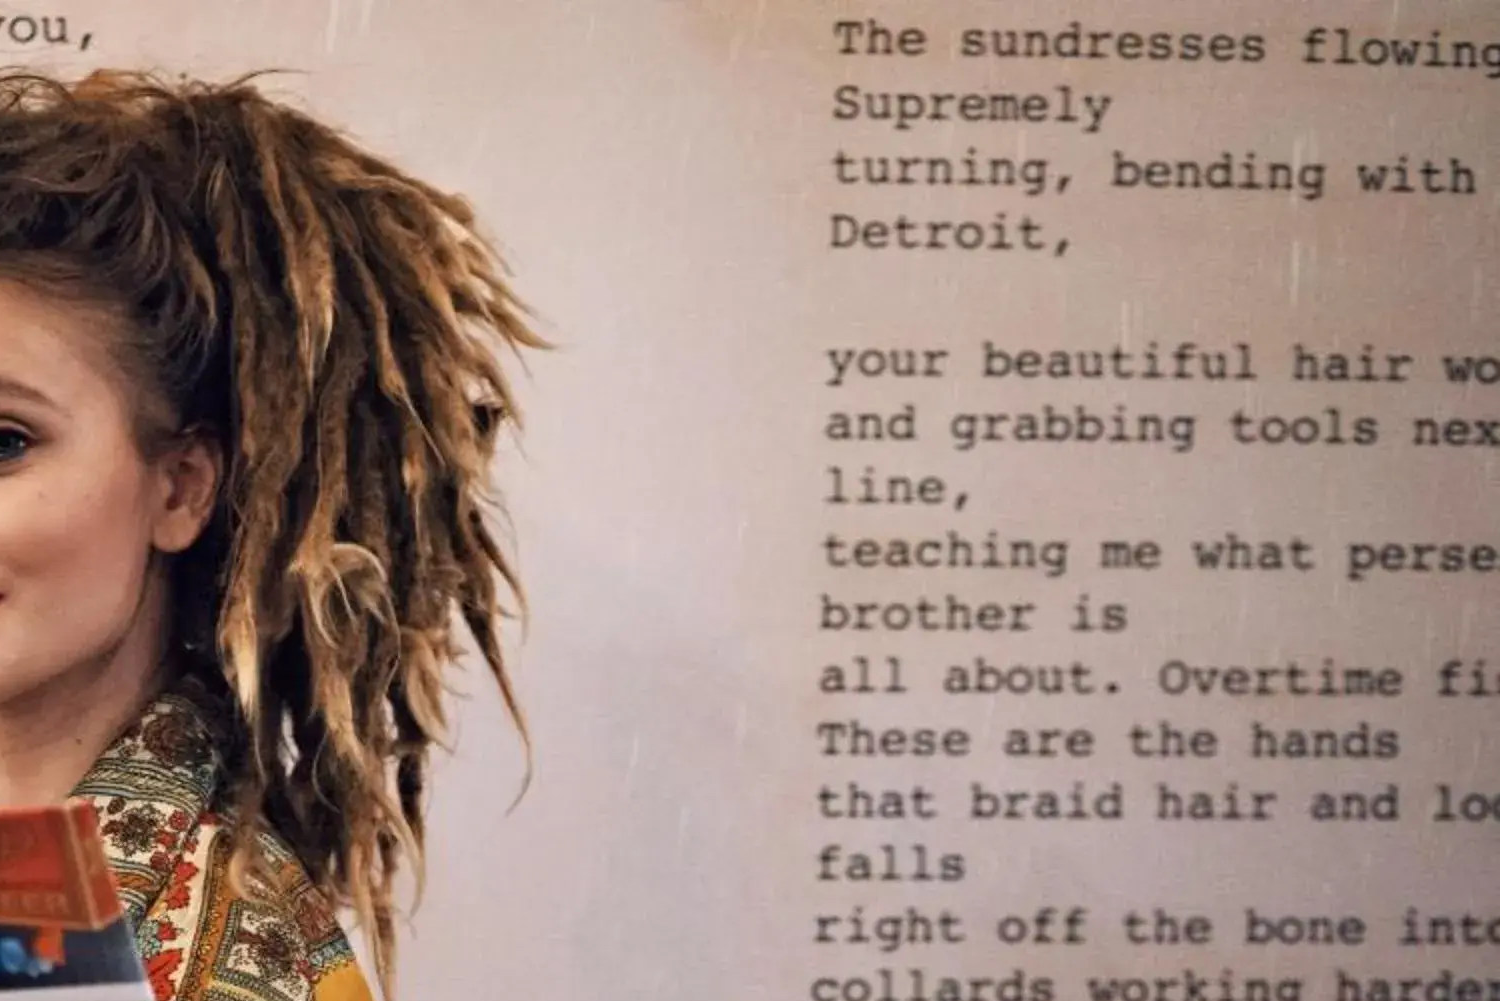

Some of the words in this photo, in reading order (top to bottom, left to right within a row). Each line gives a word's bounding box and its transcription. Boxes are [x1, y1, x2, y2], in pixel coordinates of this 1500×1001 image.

[833, 18, 927, 56] The
[960, 21, 1265, 62] sundresses
[832, 85, 1112, 133] Supremely
[832, 147, 1071, 197] turning,
[1111, 150, 1326, 201] bending
[1357, 156, 1476, 195] with
[830, 213, 1069, 257] Detroit,
[824, 404, 916, 441] and
[950, 405, 1196, 453] grabbing
[1229, 408, 1378, 445] tools
[1413, 418, 1500, 447] nex
[825, 466, 968, 511] line,
[822, 531, 1068, 578] teaching
[1100, 541, 1162, 570] me
[1191, 533, 1314, 571] what
[1347, 543, 1499, 581] perse
[819, 593, 1036, 632] brother
[1071, 594, 1127, 632] is
[816, 720, 971, 757] These
[1003, 729, 1095, 757] are
[1128, 721, 1218, 758] the
[1251, 722, 1399, 759] hands
[817, 844, 966, 882] falls
